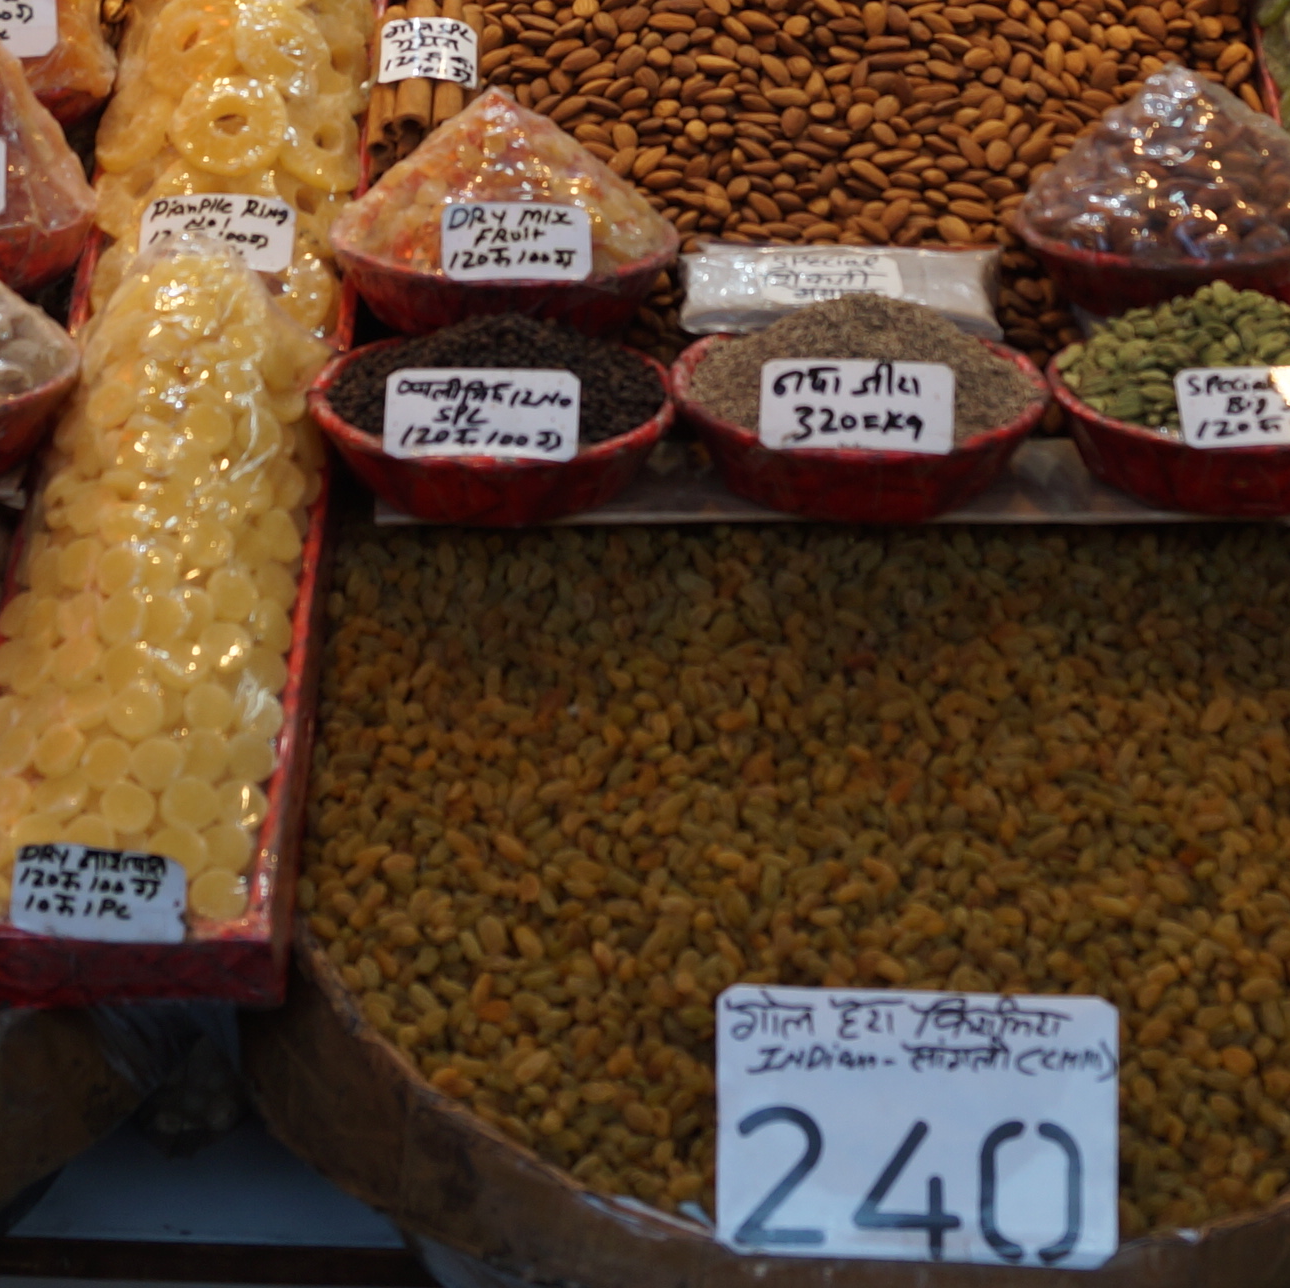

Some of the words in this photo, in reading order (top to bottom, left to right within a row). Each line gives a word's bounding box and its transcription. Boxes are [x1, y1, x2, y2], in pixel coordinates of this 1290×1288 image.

[448, 208, 507, 230] DRY
[726, 990, 814, 1040] गोल
[829, 995, 904, 1040] हरा
[734, 1106, 1083, 1262] 240
